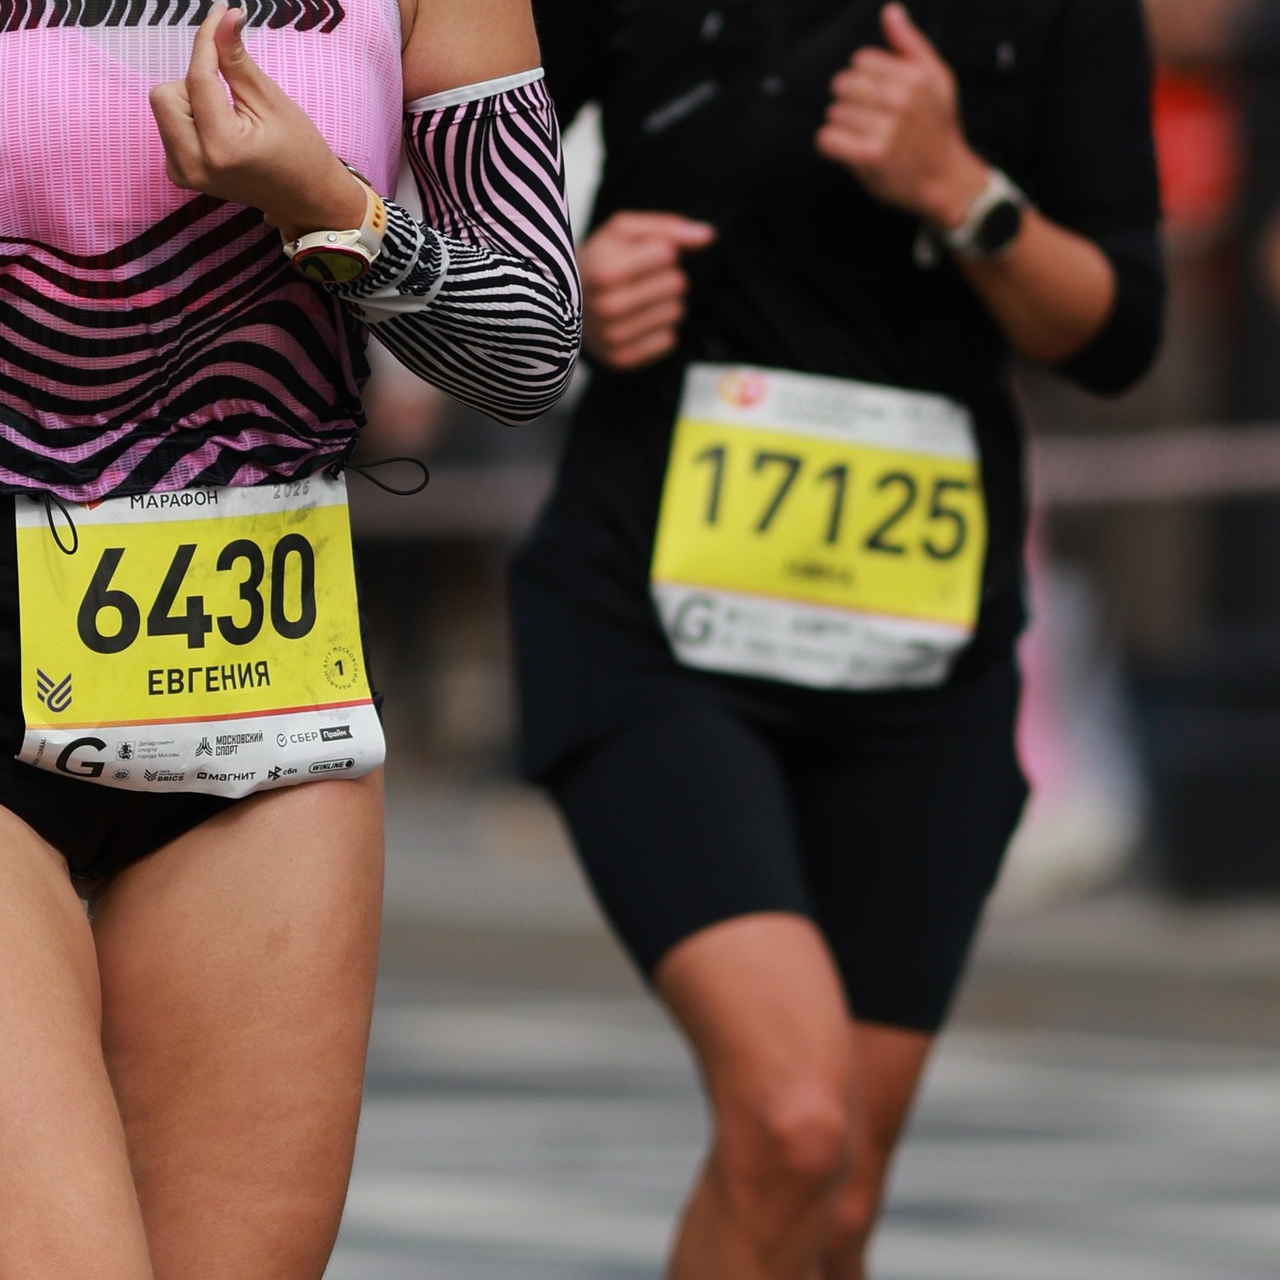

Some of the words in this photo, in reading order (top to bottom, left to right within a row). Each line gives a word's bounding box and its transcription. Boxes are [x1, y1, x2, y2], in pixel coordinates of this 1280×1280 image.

[273, 480, 310, 499] 2026
[130, 491, 218, 510] МАРАФОН
[694, 444, 970, 562] 17125
[76, 533, 317, 654] 6430
[334, 659, 344, 676] 1
[148, 661, 271, 695] ЕВГЕНИЯ
[216, 730, 263, 746] МОСКОВСКИЙ
[290, 732, 318, 744] СБЕР
[323, 728, 347, 739] Прайм
[55, 737, 107, 778] G
[216, 745, 238, 756] СПОРТ
[312, 761, 345, 771] WINLINE
